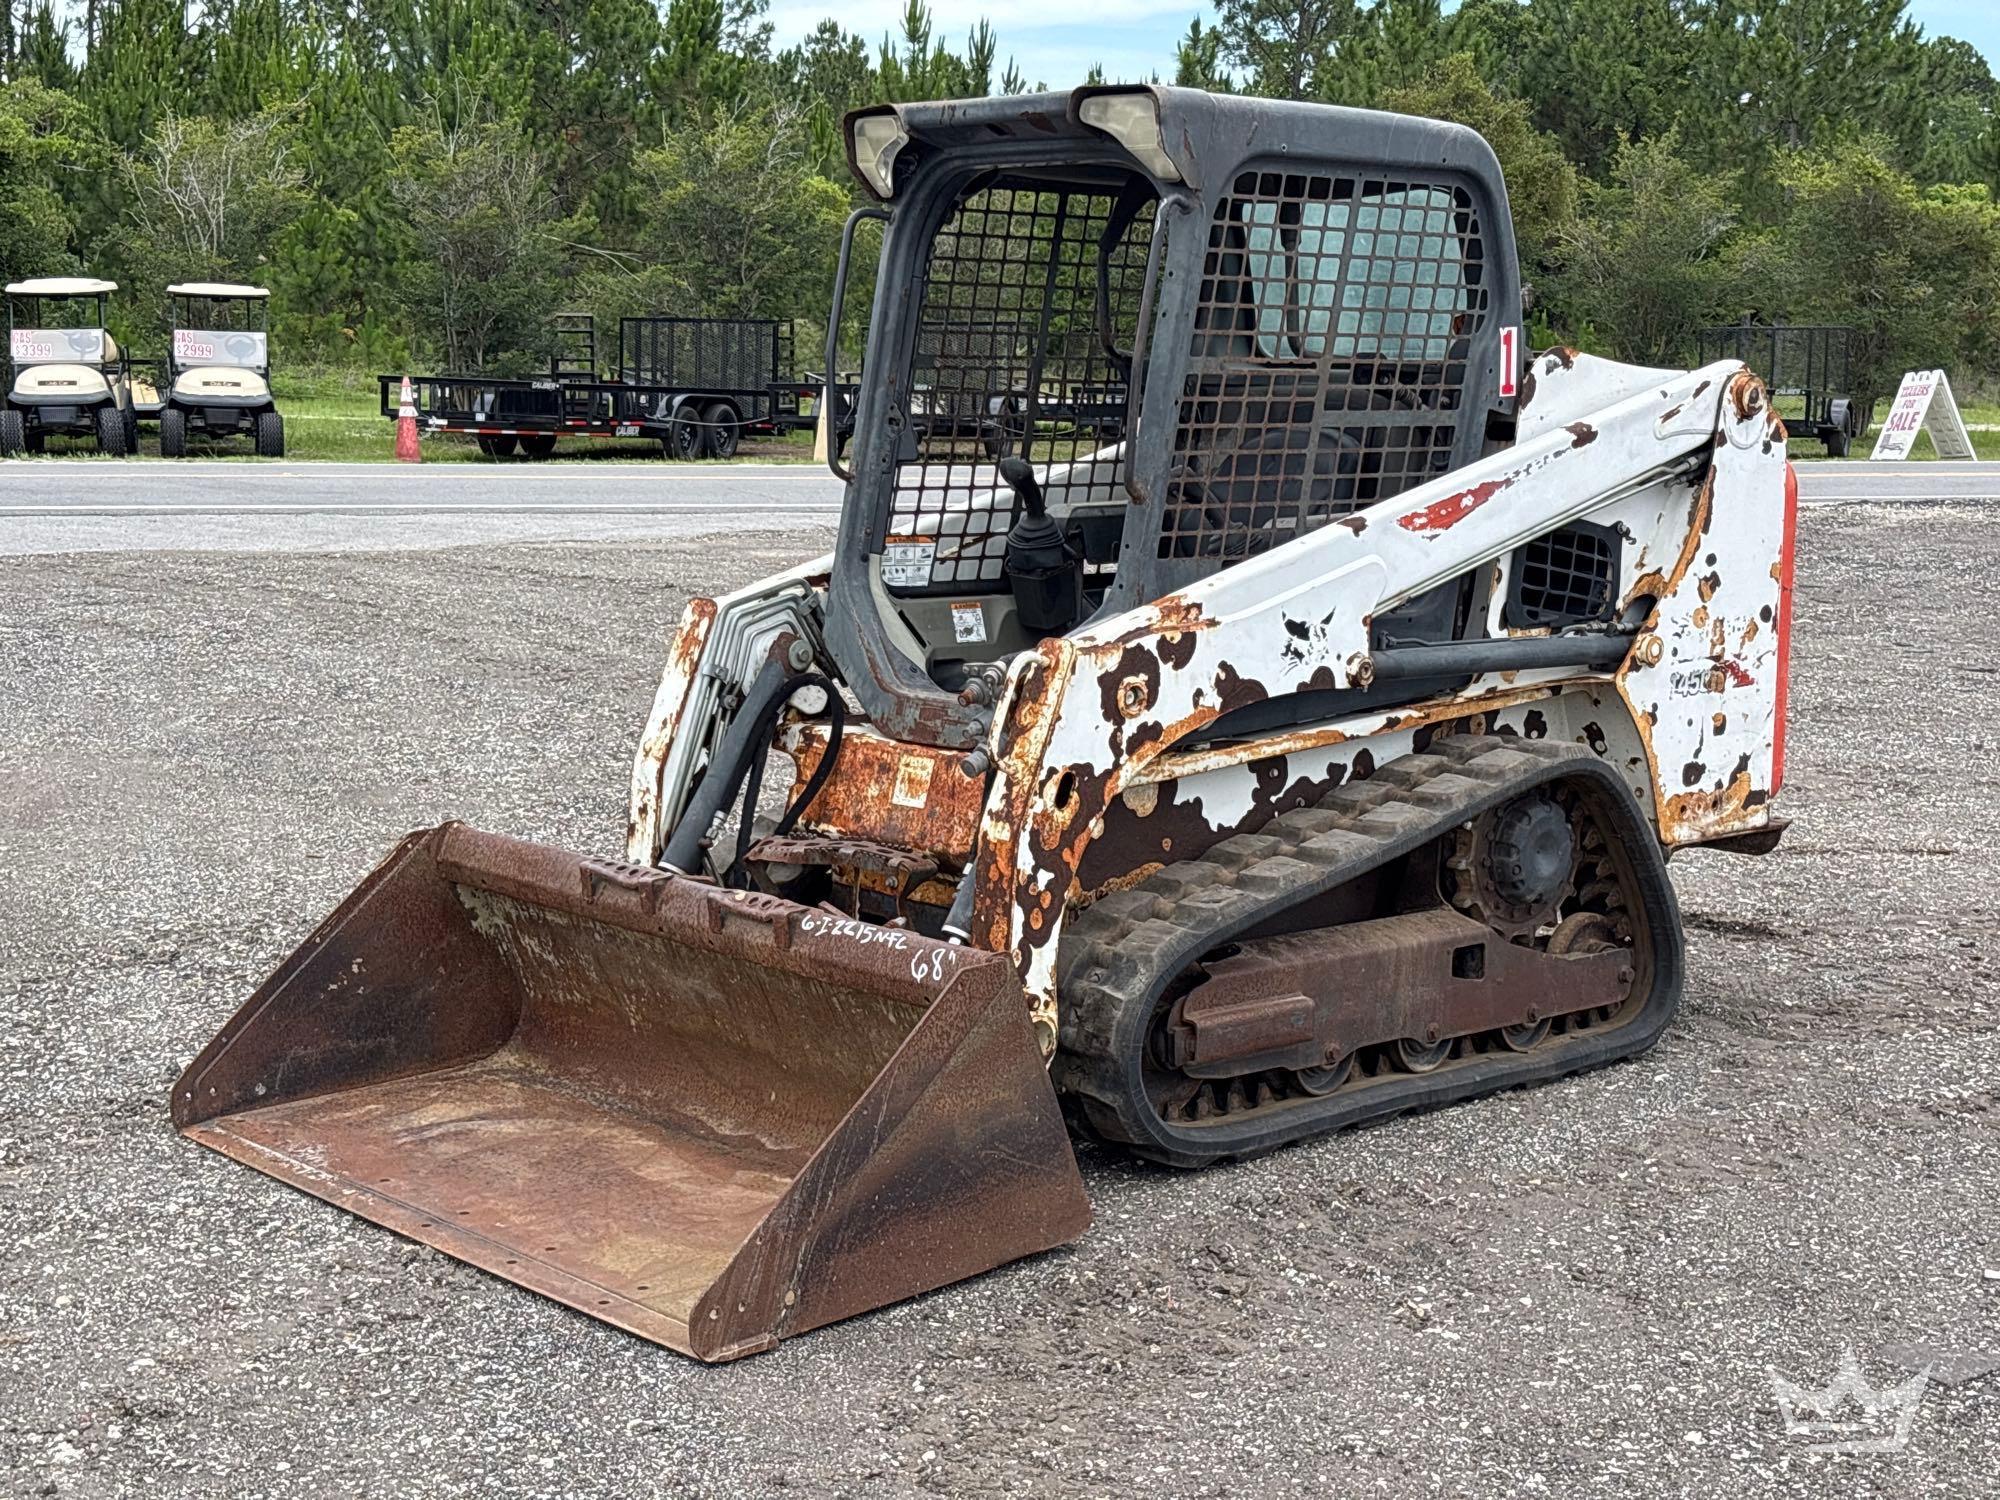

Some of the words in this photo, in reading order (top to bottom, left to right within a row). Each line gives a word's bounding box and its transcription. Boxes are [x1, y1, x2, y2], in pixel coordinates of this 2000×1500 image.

[13, 331, 32, 344] GAS
[175, 331, 193, 344] GAS
[16, 344, 51, 357] $3399
[177, 344, 212, 357] $2999
[1502, 330, 1514, 395] 1
[1902, 399, 1917, 409] FOR
[1886, 411, 1920, 432] SALE
[616, 425, 640, 437] CALIBER
